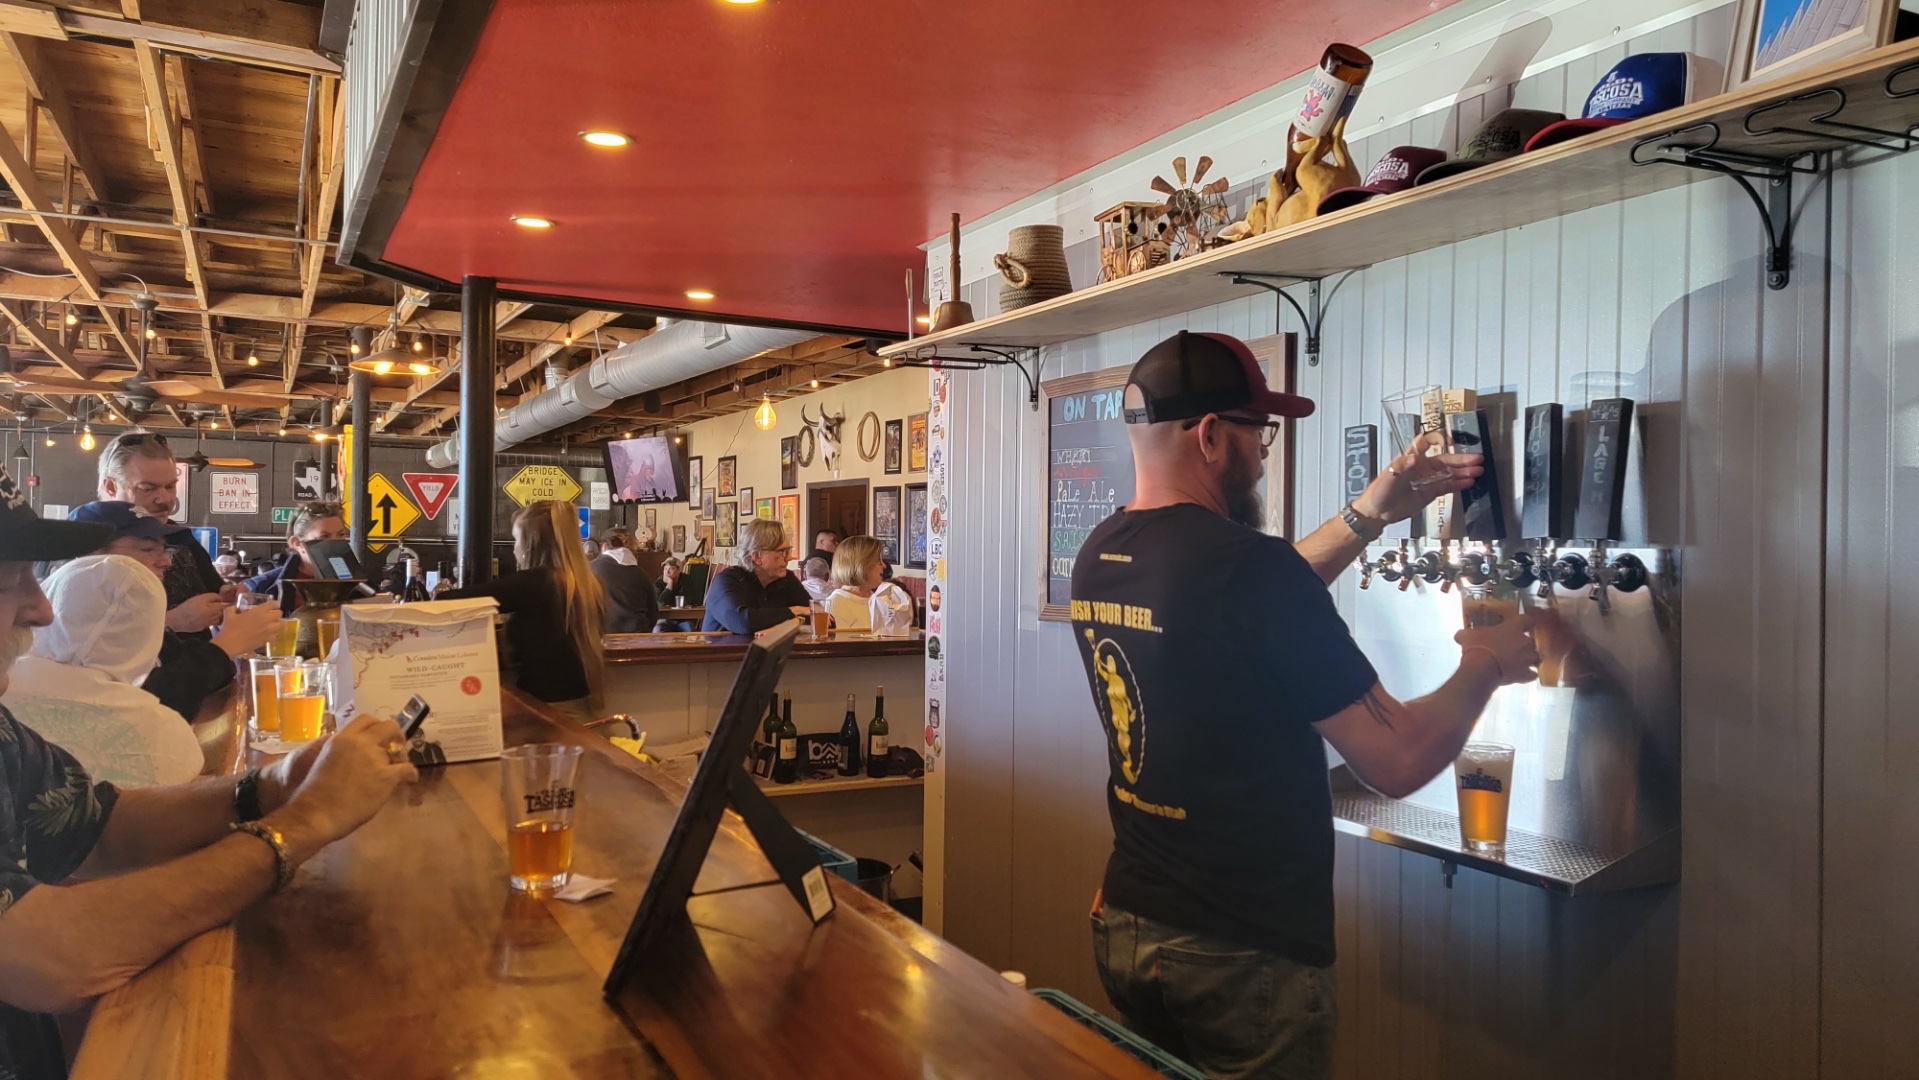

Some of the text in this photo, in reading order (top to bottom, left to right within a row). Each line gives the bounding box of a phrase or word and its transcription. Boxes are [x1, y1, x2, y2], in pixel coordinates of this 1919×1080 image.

[1063, 389, 1123, 422] ON TAP
[528, 466, 558, 476] BRIDGE
[223, 477, 247, 485] BURN
[519, 477, 567, 486] MAY ICE IN
[423, 484, 440, 492] YIELD
[532, 488, 554, 497] COLD
[219, 489, 251, 497] BAN IN
[218, 501, 251, 509] EFFECT
[1053, 502, 1084, 529] HAZY
[1092, 601, 1122, 626] YOUR
